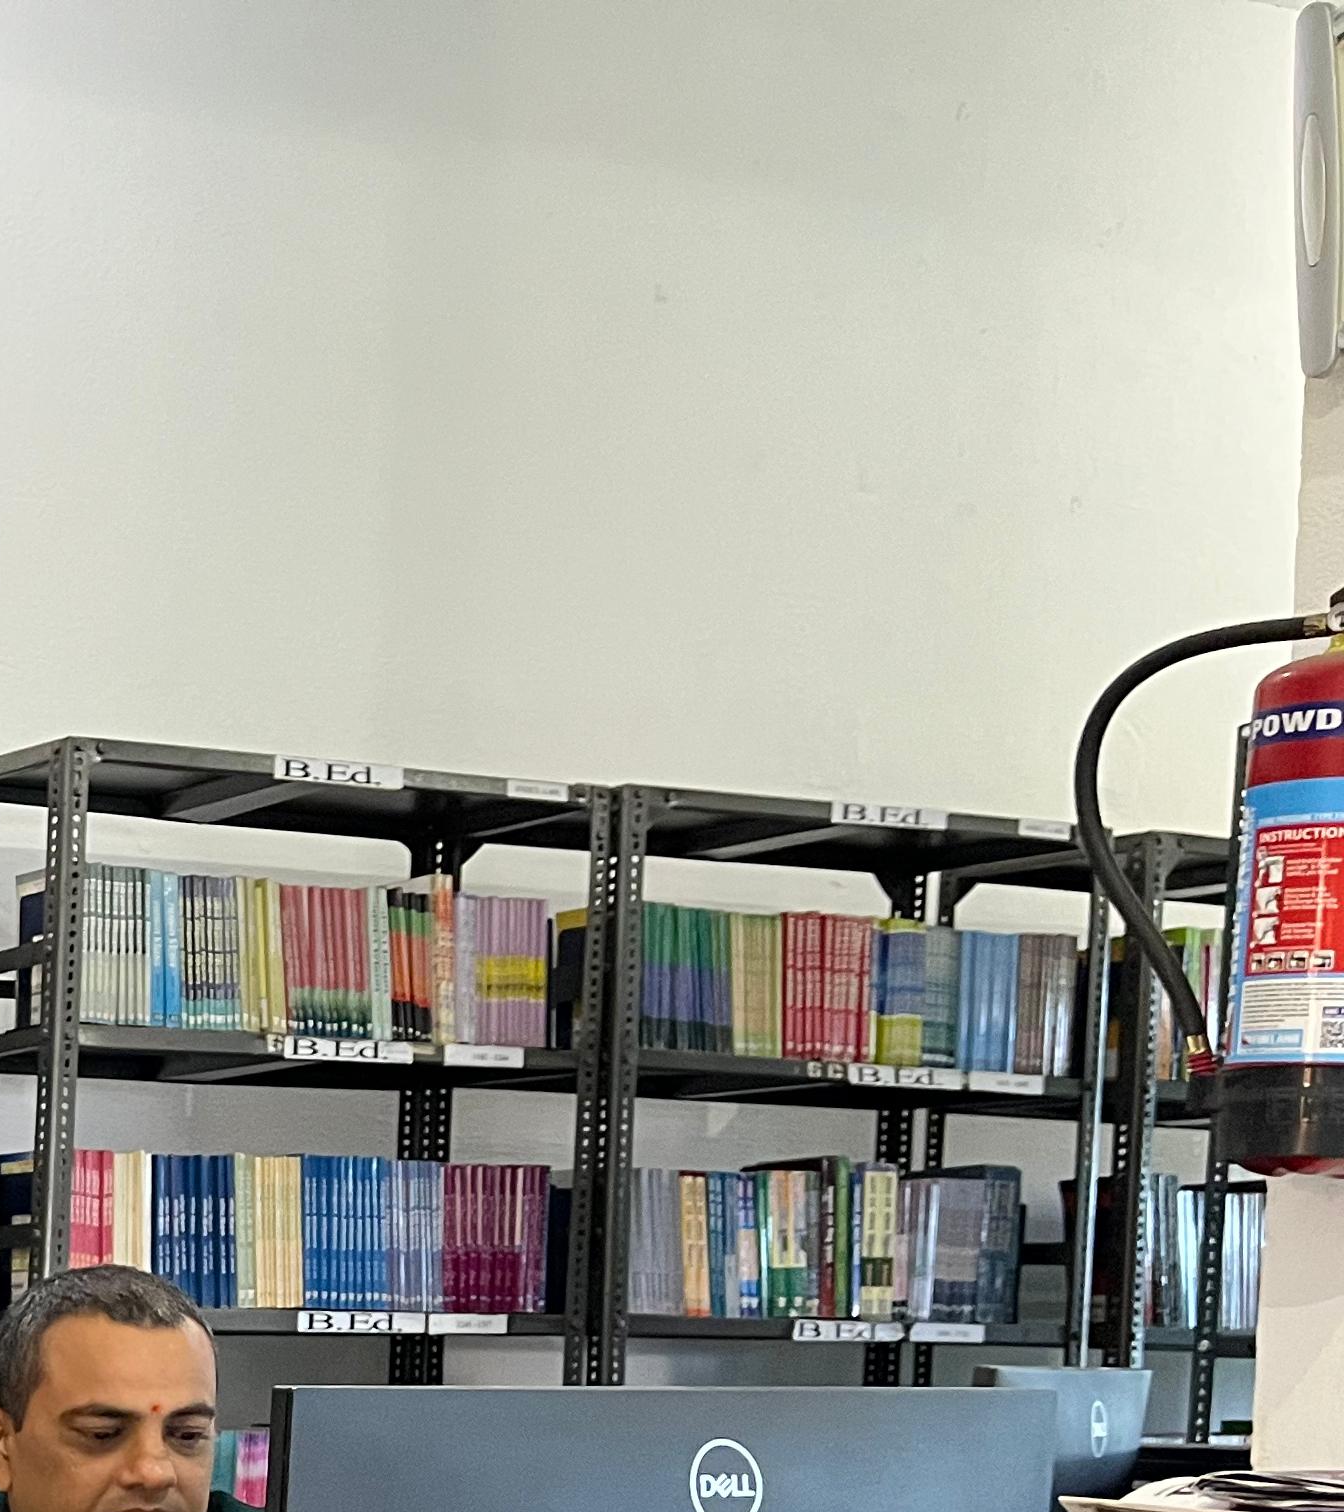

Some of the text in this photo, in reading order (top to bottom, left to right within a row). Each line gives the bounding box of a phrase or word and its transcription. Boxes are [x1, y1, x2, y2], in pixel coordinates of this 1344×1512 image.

[282, 759, 382, 785] B.Ed.
[840, 804, 931, 826] B.Ed.
[291, 1038, 388, 1060] B.Ed.
[856, 1066, 939, 1089] B.Ed.
[306, 1312, 403, 1332] B.Ed.
[698, 1474, 755, 1499] DELL
